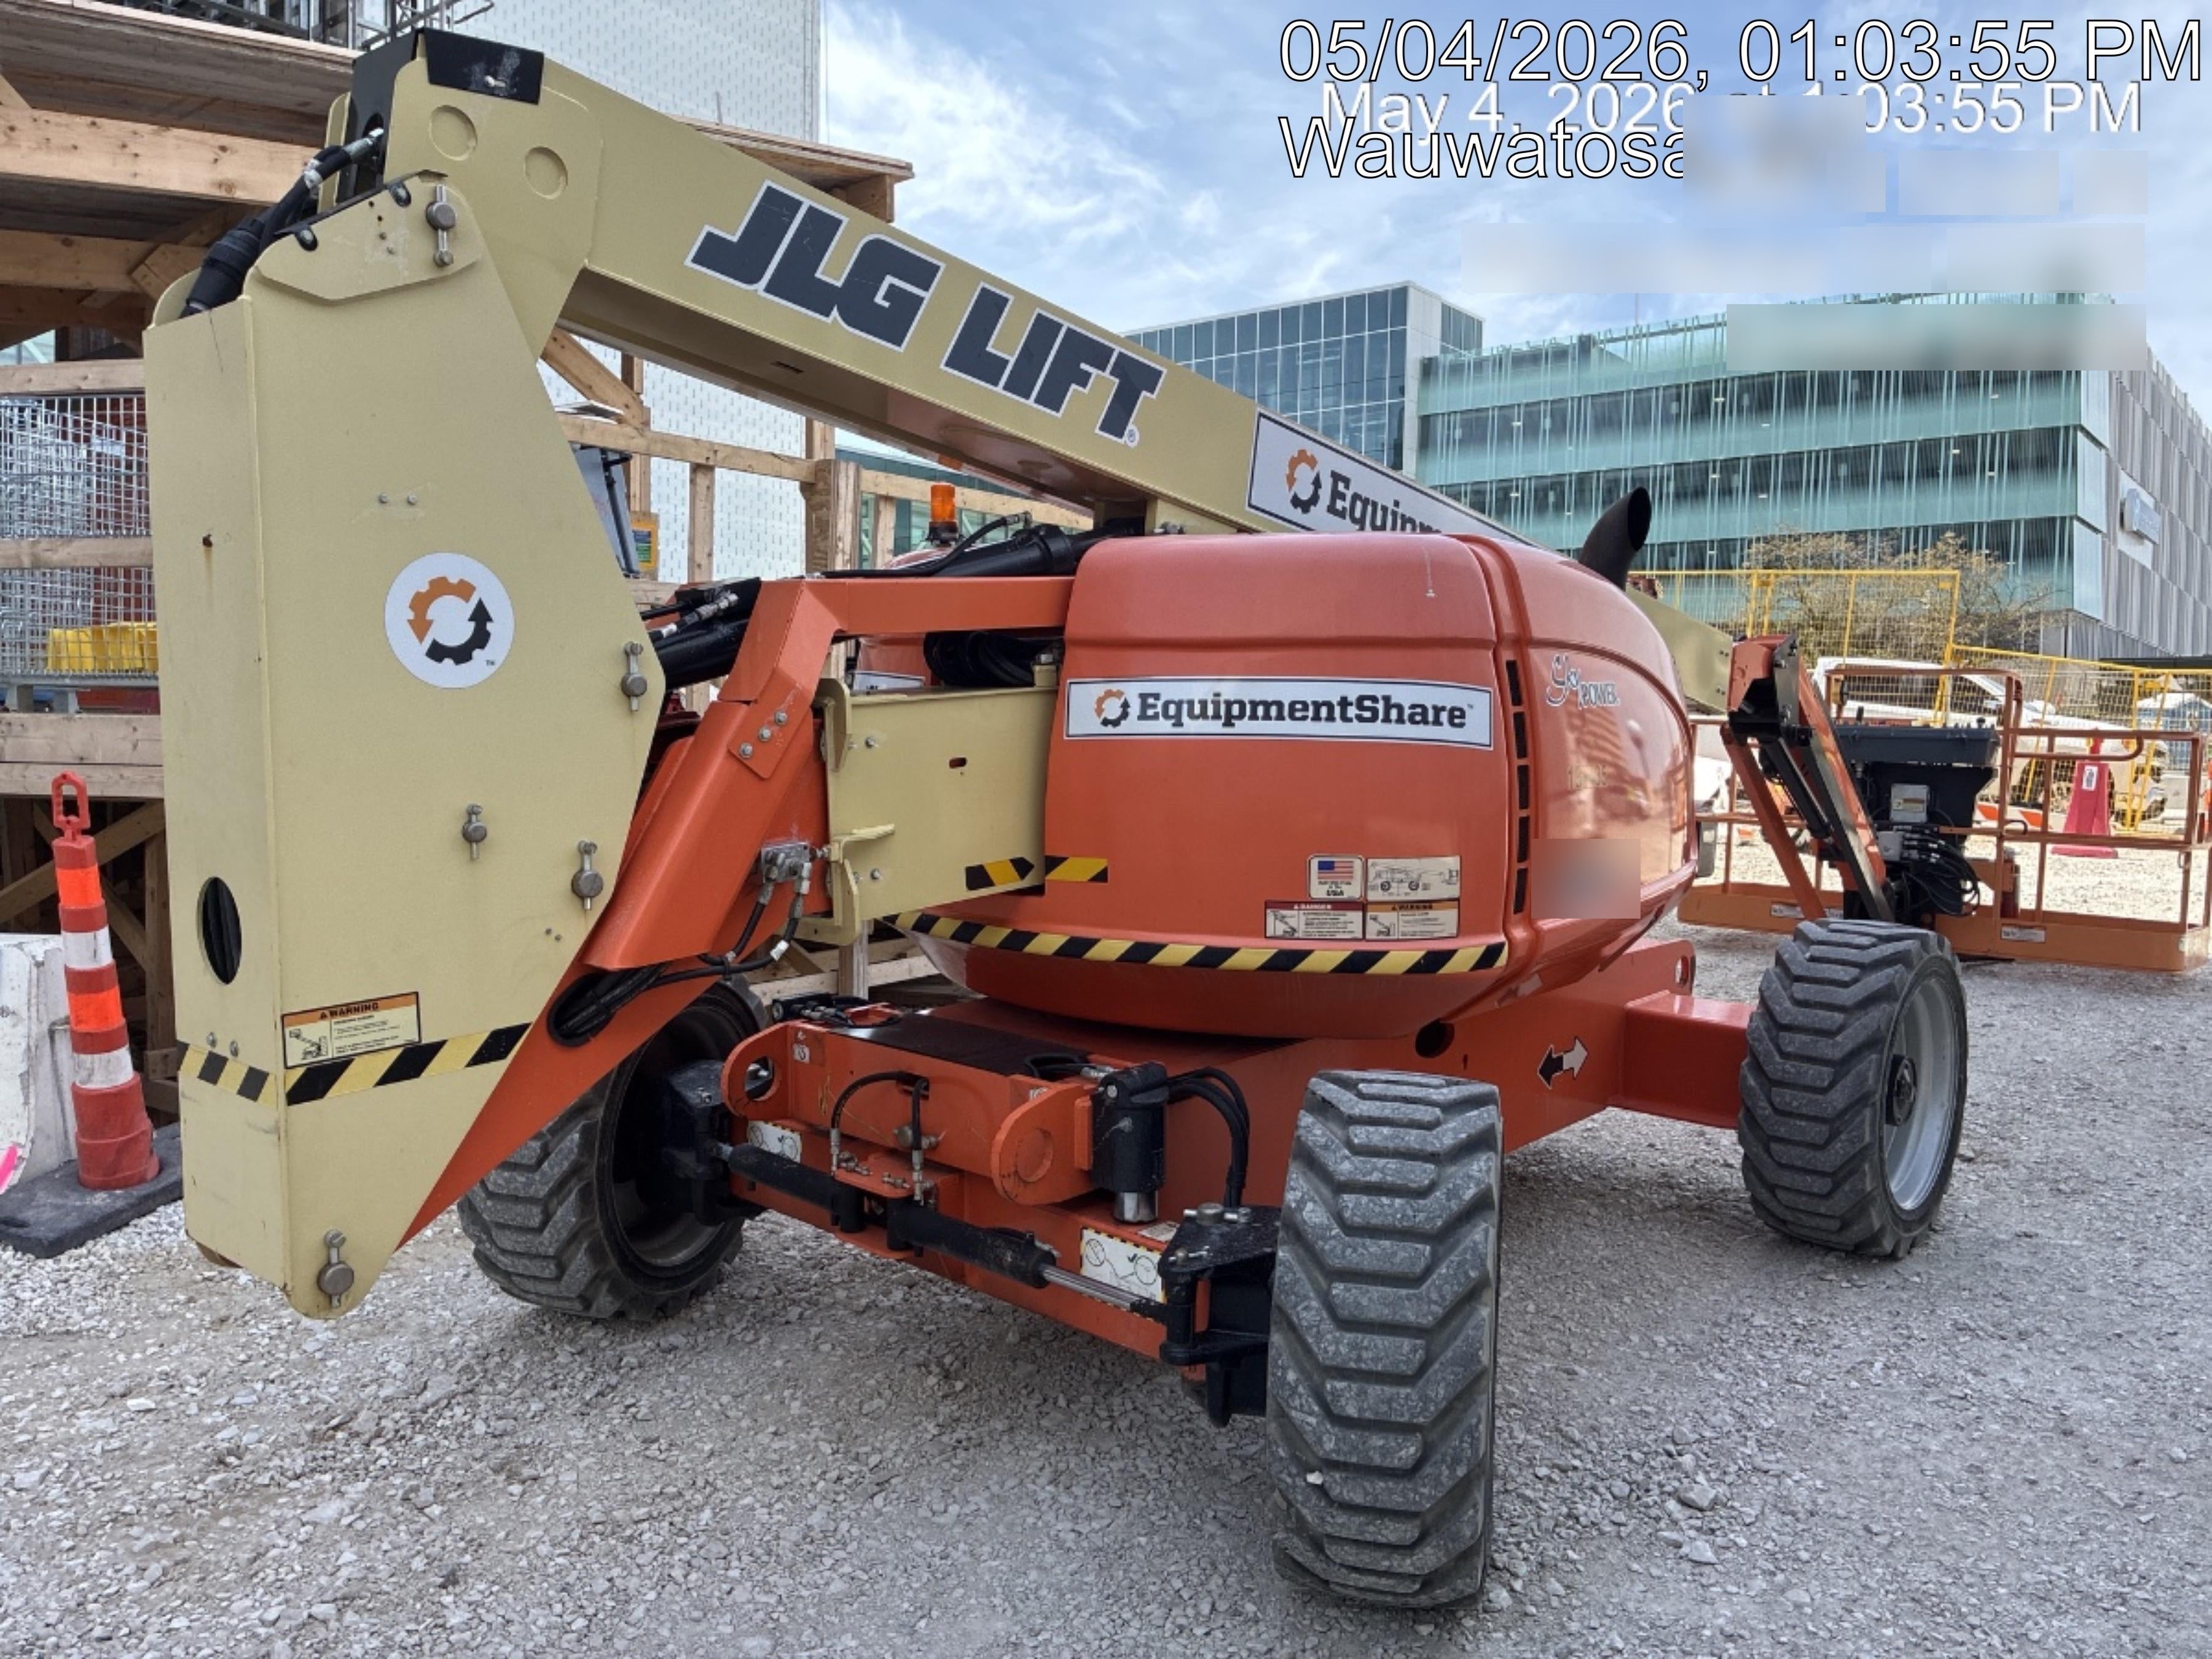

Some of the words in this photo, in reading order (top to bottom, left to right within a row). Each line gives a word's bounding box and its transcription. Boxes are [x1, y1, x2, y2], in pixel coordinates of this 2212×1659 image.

[684, 179, 946, 352] JLG
[940, 281, 1166, 446] LIFT
[1327, 476, 1442, 533] Equi
[1137, 691, 1467, 729] EquipmentShare
[329, 1002, 379, 1018] WARNING
